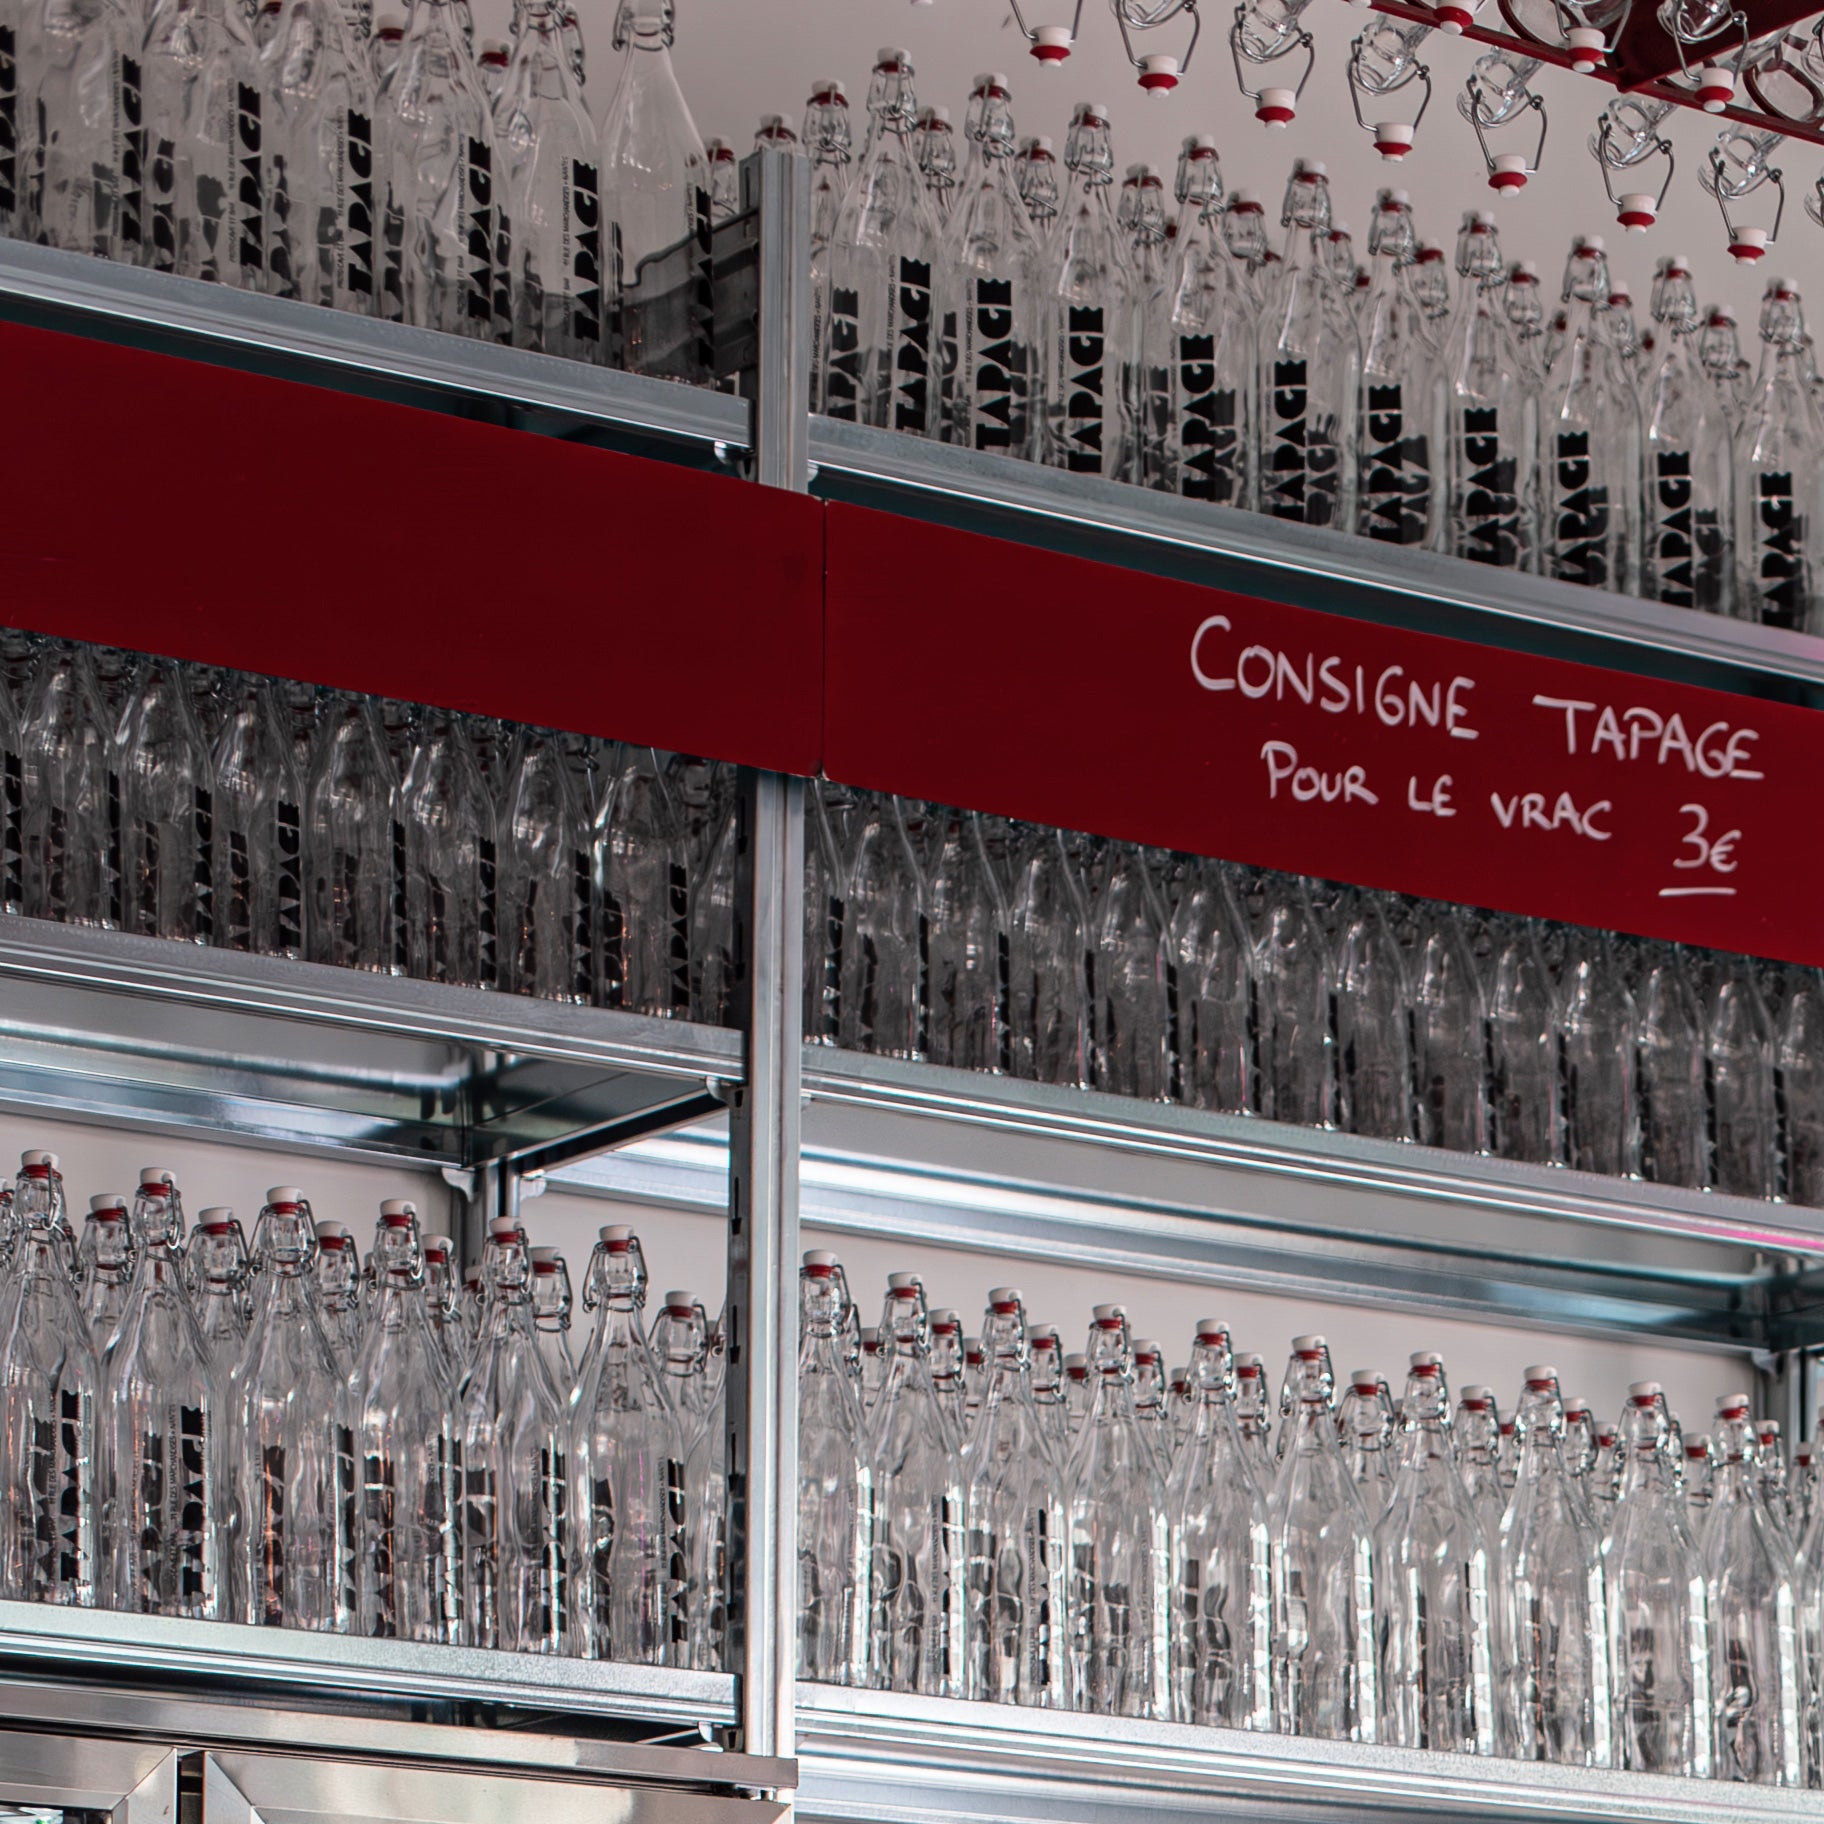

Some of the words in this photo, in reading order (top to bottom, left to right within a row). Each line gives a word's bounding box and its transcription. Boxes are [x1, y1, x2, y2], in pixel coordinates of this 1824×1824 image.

[238, 81, 262, 270] TAPAGE
[348, 108, 372, 296] TAPAGE
[468, 136, 491, 322] TAPAGE
[573, 158, 599, 341] TAPAGE
[827, 287, 858, 421] APAGE
[896, 256, 930, 432] TAPAGE
[976, 276, 1012, 451] TAPAGE
[1068, 305, 1103, 474] TAPAGE
[1181, 335, 1216, 502] TAPAGE
[1272, 360, 1307, 521] TAPAGE
[1190, 615, 1479, 738] CONSIGNE
[1533, 695, 1764, 779] TAPAGE
[1408, 775, 1457, 816] LE
[1490, 792, 1612, 840] VRAC
[1673, 803, 1742, 872] 3€
